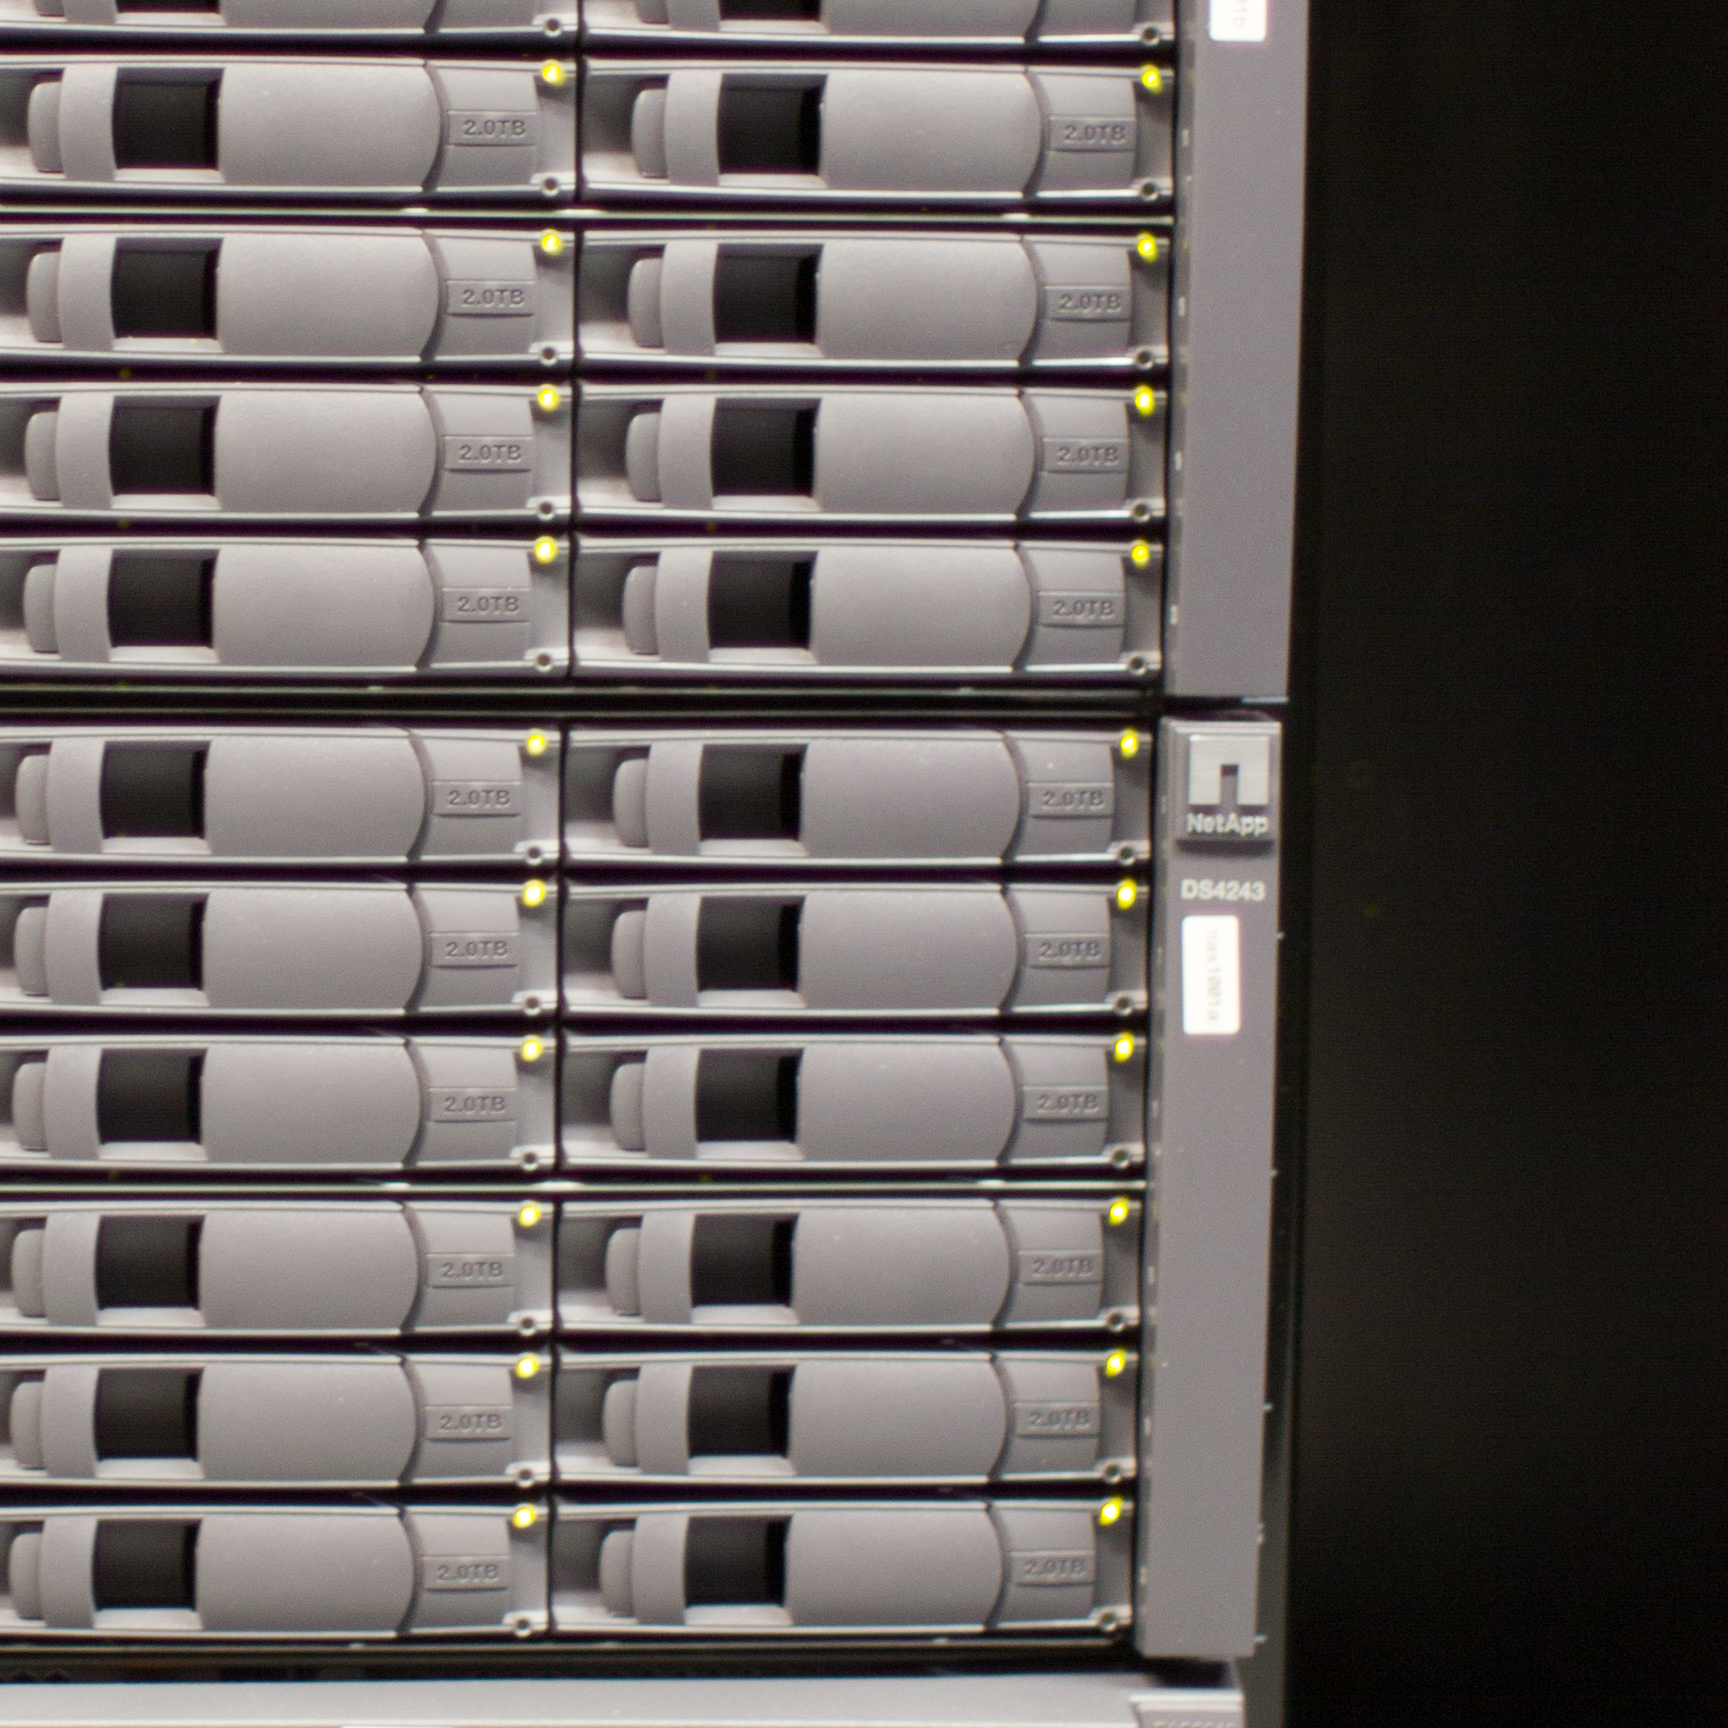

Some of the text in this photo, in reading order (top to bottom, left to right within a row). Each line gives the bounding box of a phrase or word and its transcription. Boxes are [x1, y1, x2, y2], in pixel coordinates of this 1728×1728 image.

[462, 117, 527, 136] 2.0TB
[461, 286, 526, 305] 2.0TB
[458, 442, 523, 462] 2.0TB
[456, 594, 521, 614] 2.0TB
[446, 788, 511, 807] 2.0TB
[1186, 812, 1269, 838] NetApp
[1181, 879, 1266, 902] DS4243
[444, 939, 509, 958] 2.0TB
[442, 1094, 507, 1113] 2.0TB
[440, 1259, 505, 1279] 2.0TB
[438, 1412, 503, 1431] 2.0TB
[436, 1562, 501, 1581] 2.0TB
